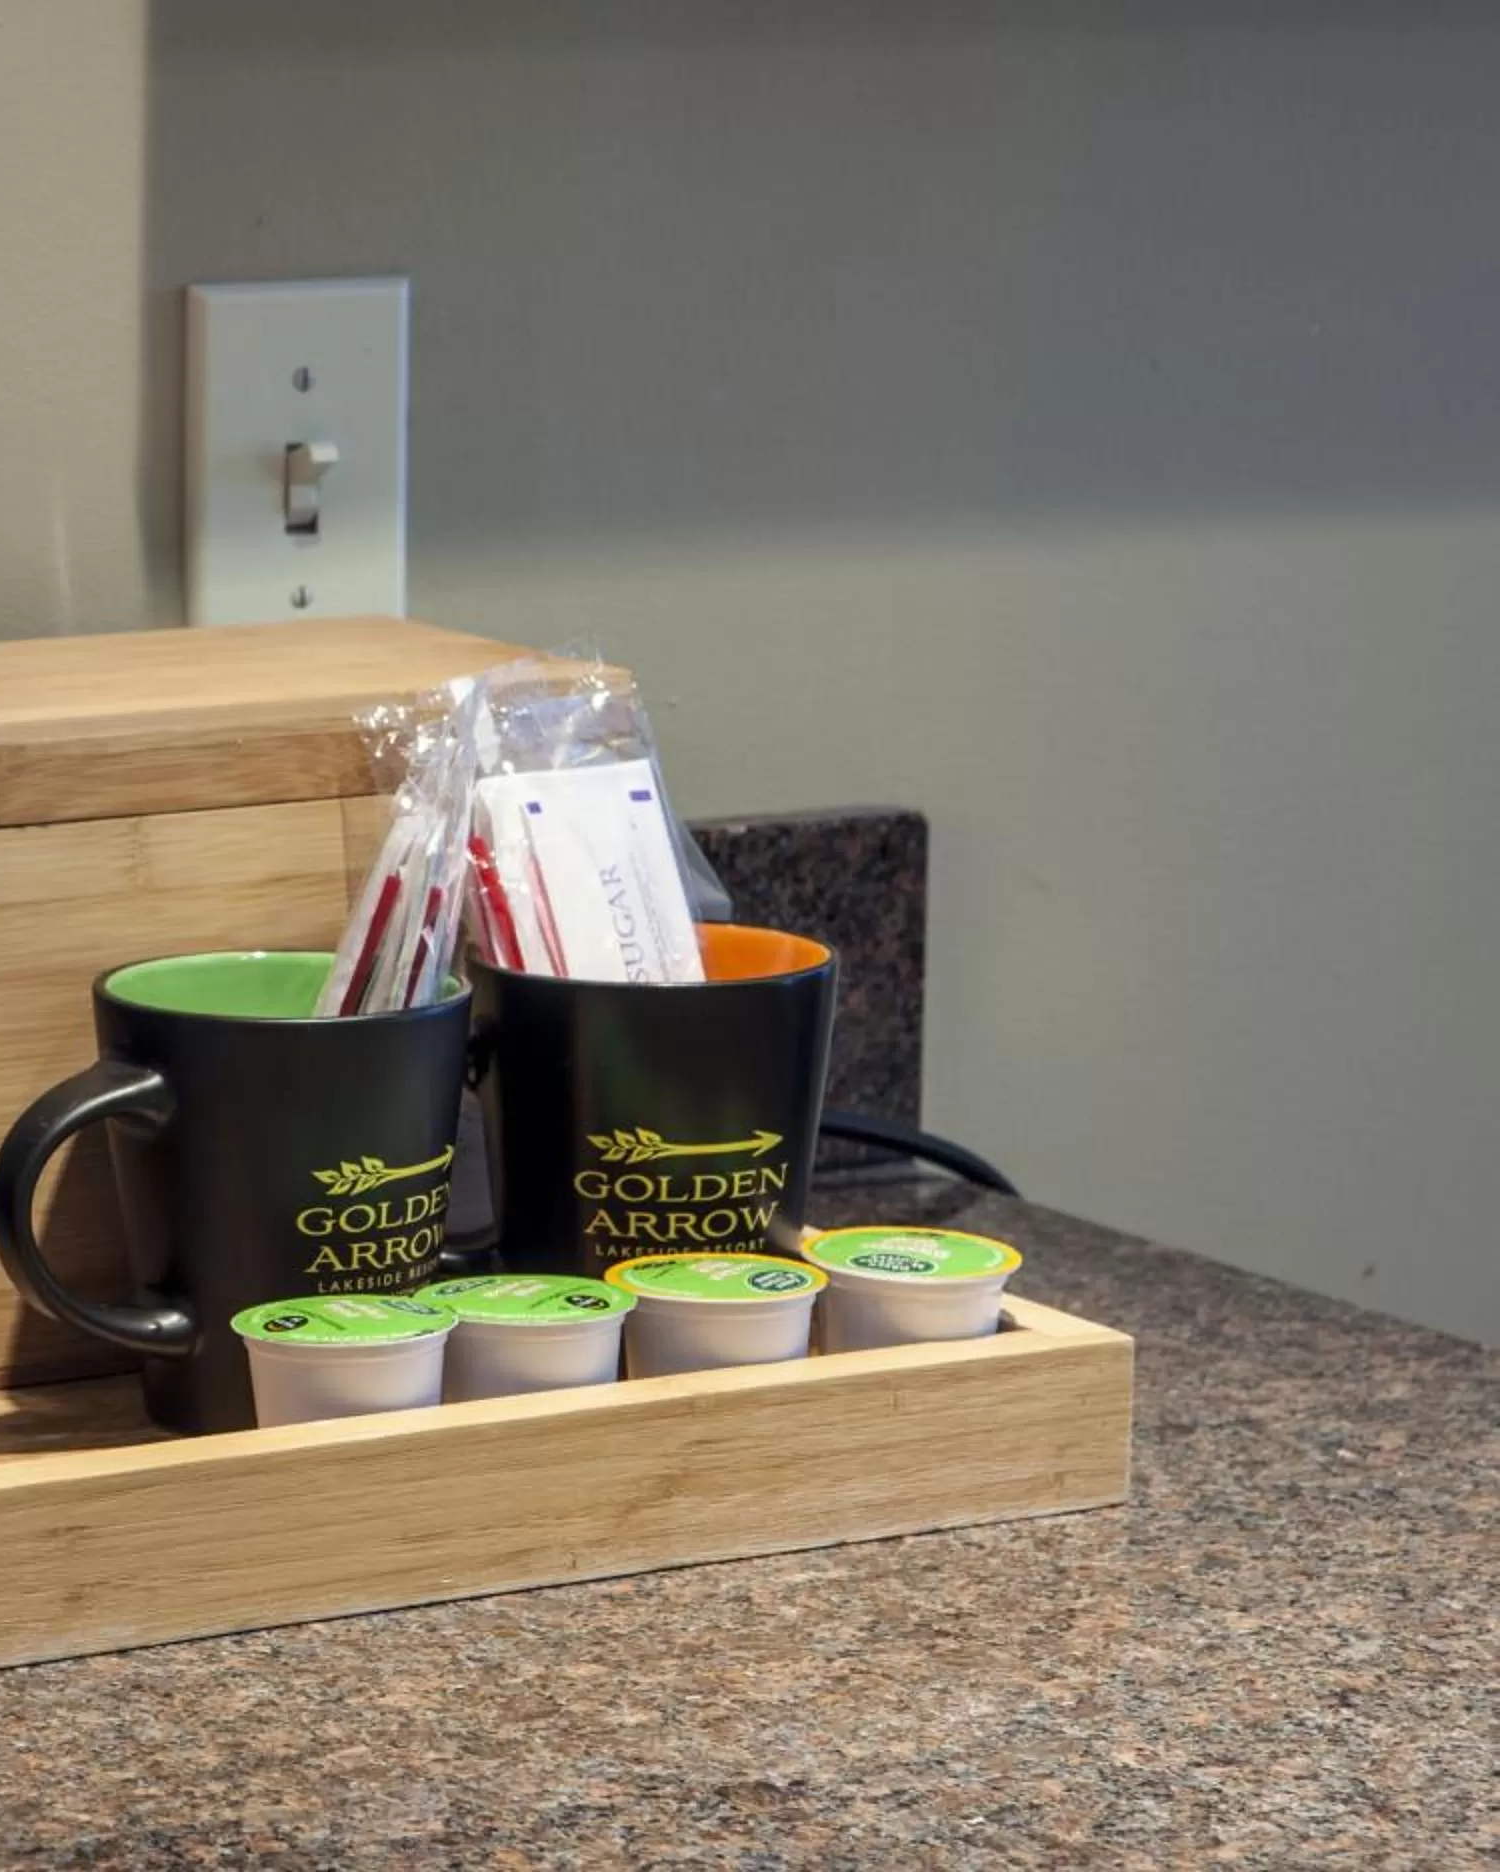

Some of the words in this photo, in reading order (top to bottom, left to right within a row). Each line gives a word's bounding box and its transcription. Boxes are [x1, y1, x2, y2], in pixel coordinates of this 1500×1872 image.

[600, 863, 649, 983] SUGAR
[573, 1163, 789, 1202] GOLDEN
[296, 1182, 450, 1236] GOLDE
[584, 1200, 779, 1242] ARROW
[317, 1272, 402, 1294] LAKESIDE
